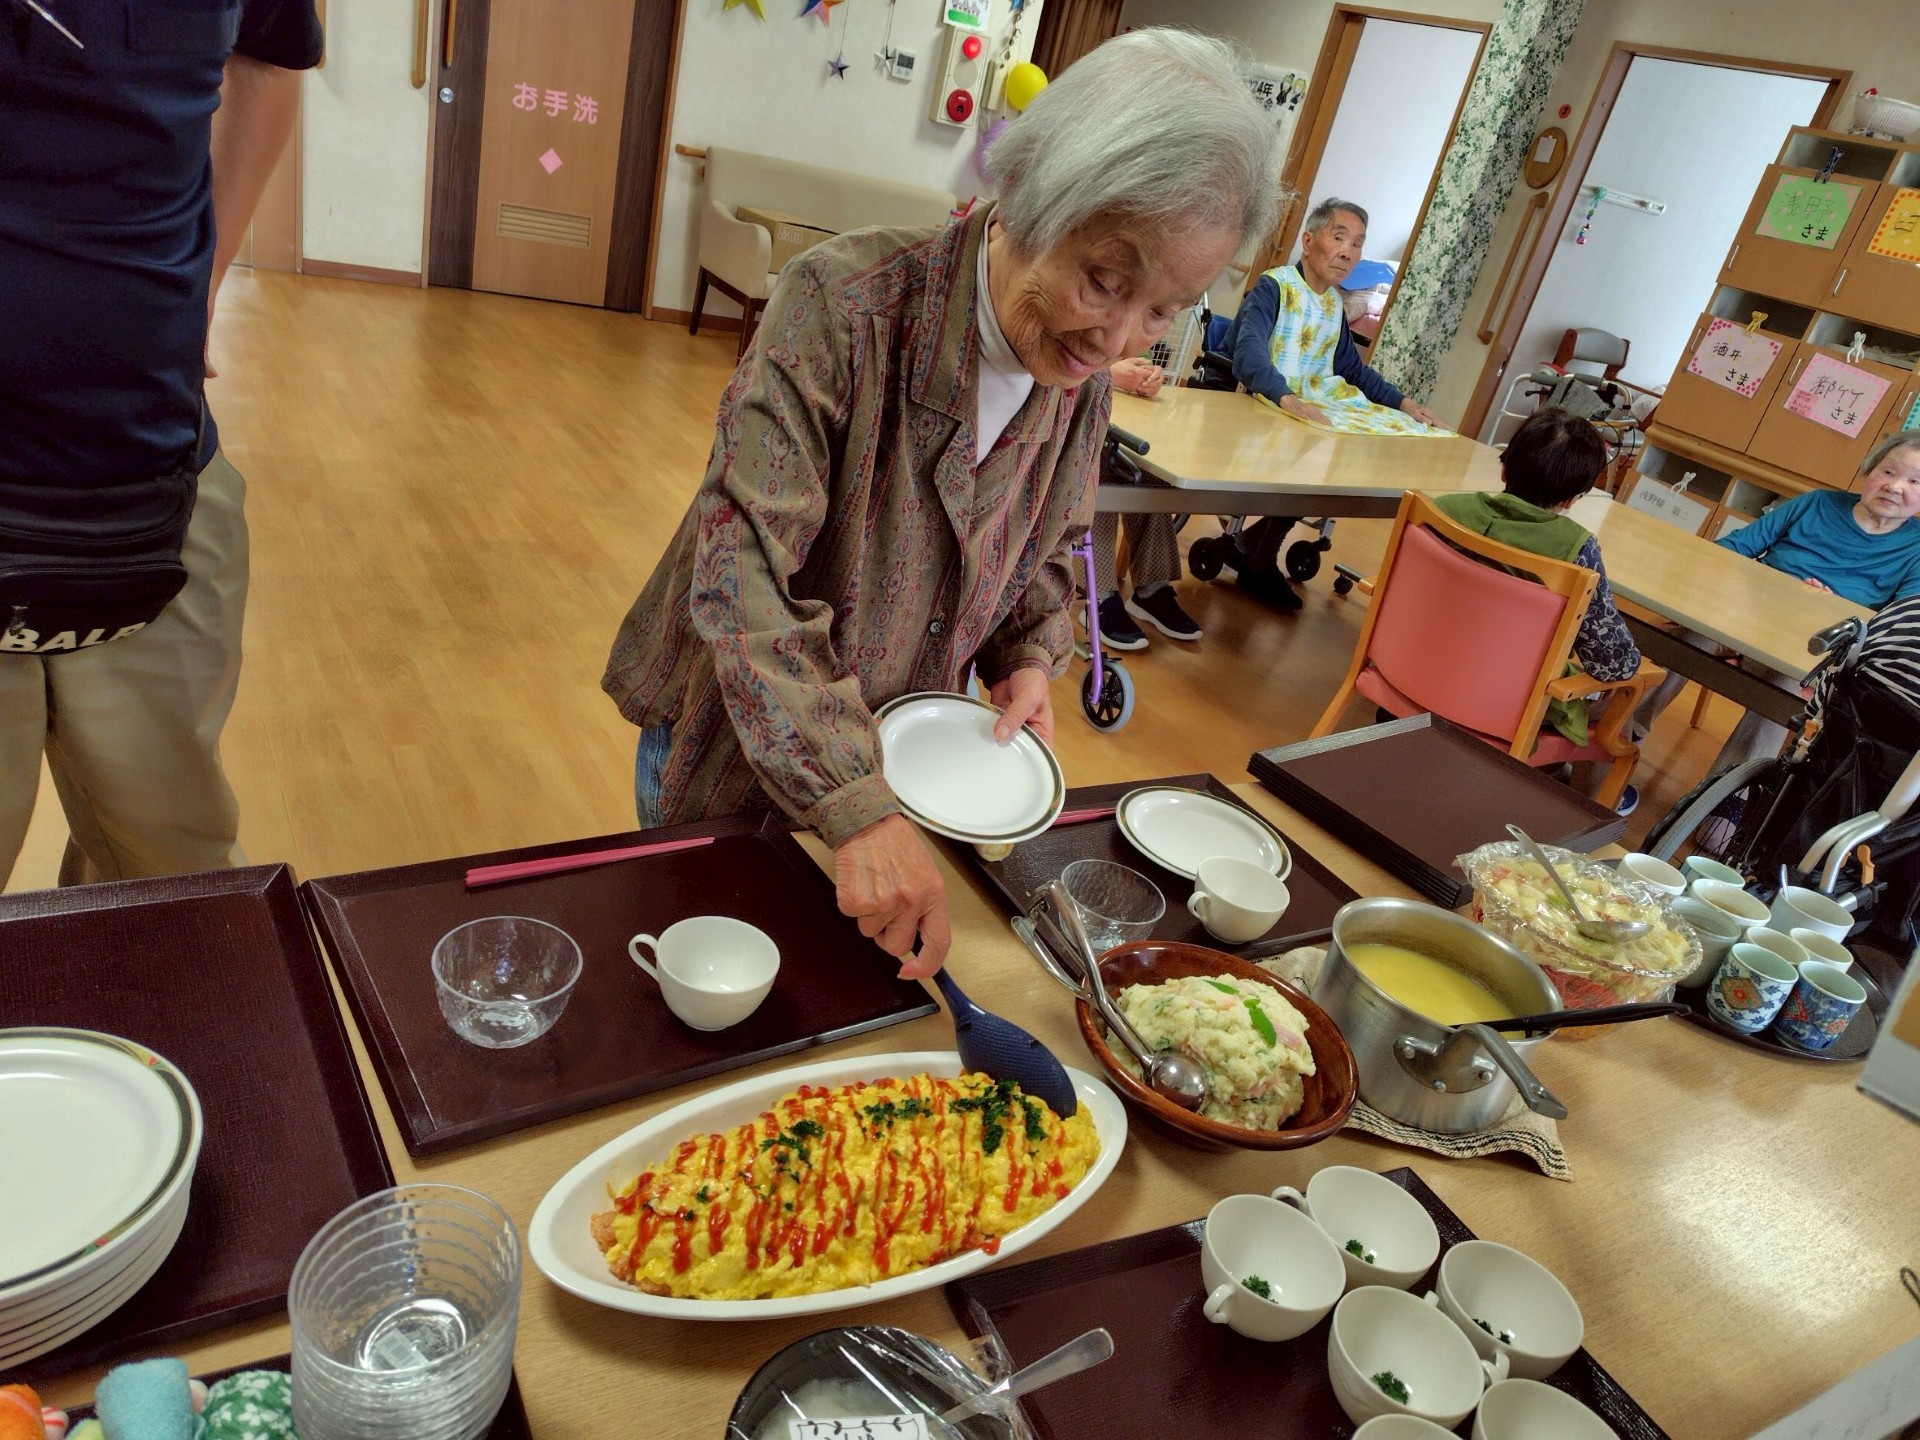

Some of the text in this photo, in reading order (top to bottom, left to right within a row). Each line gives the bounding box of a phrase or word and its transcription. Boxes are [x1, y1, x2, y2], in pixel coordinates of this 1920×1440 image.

[512, 82, 598, 125] お手洗
[1801, 224, 1829, 241] さま
[1712, 342, 1741, 361] 酒井
[1725, 368, 1749, 387] さま
[1831, 406, 1857, 425] さま
